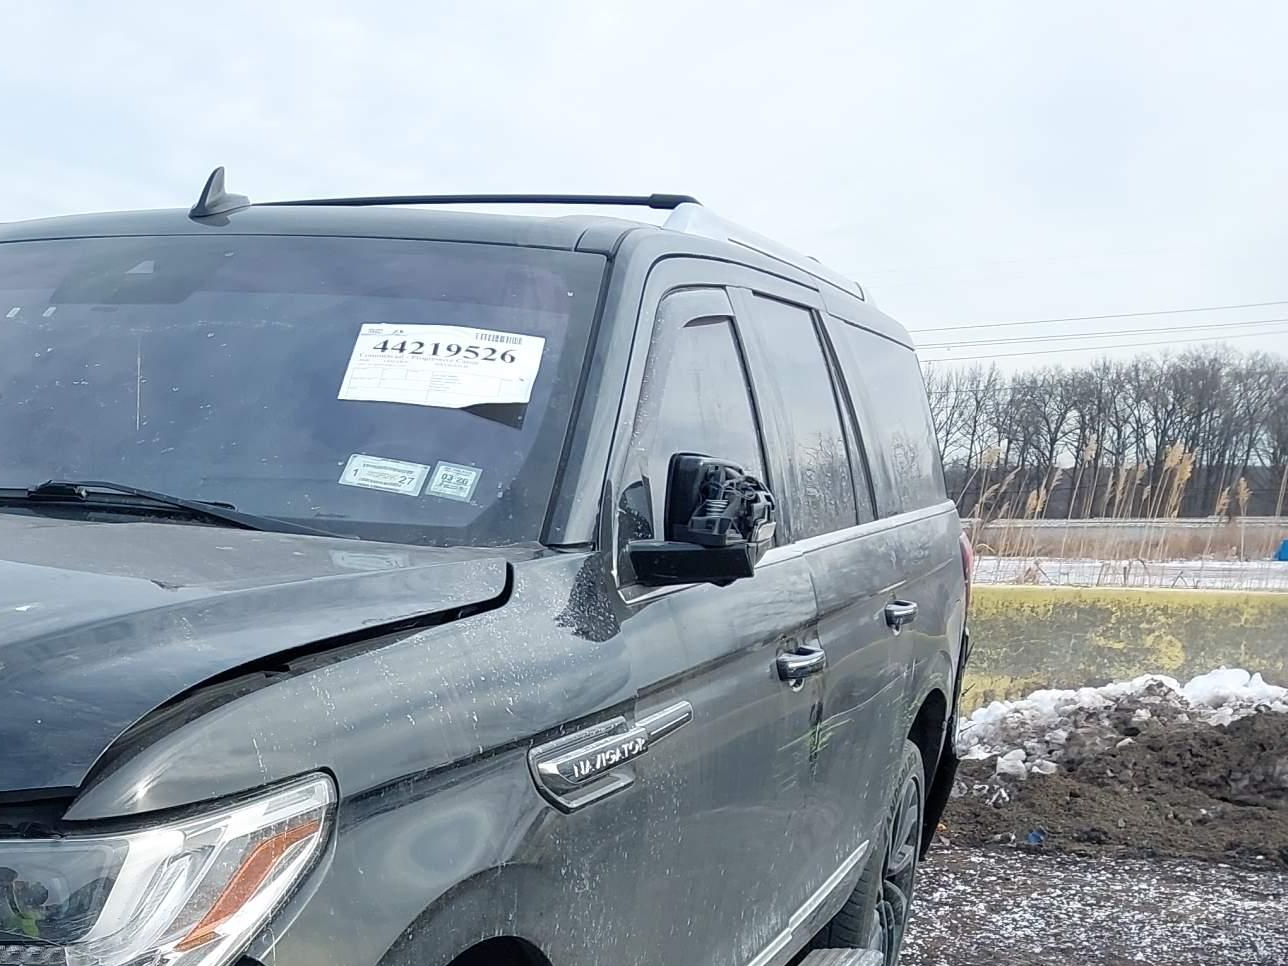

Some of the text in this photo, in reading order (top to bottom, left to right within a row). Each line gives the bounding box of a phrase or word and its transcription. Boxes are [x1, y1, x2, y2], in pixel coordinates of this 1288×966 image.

[372, 338, 518, 364] 44219526
[352, 468, 360, 478] 1
[398, 475, 416, 486] 27
